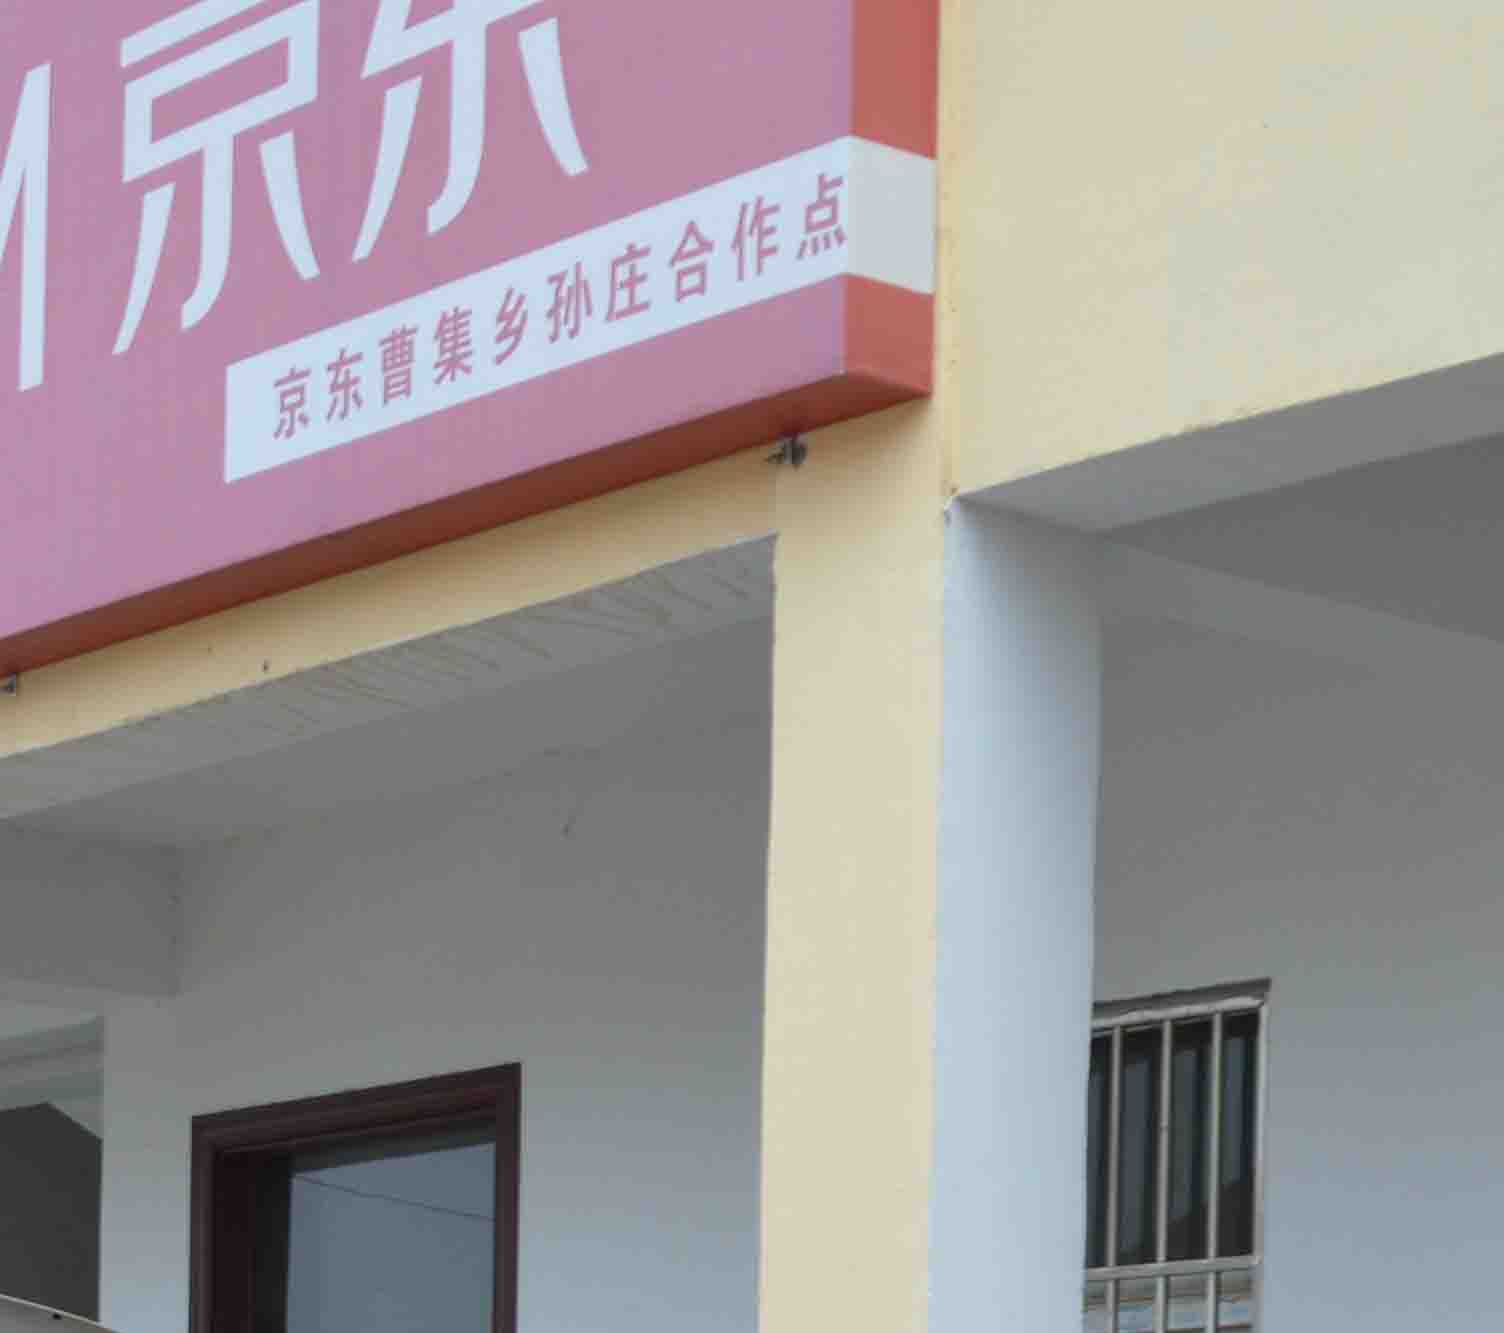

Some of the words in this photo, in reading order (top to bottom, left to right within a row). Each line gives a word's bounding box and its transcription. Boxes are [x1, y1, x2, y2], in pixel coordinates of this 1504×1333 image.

[273, 172, 847, 440] 京东曹集乡孙庄合作点
